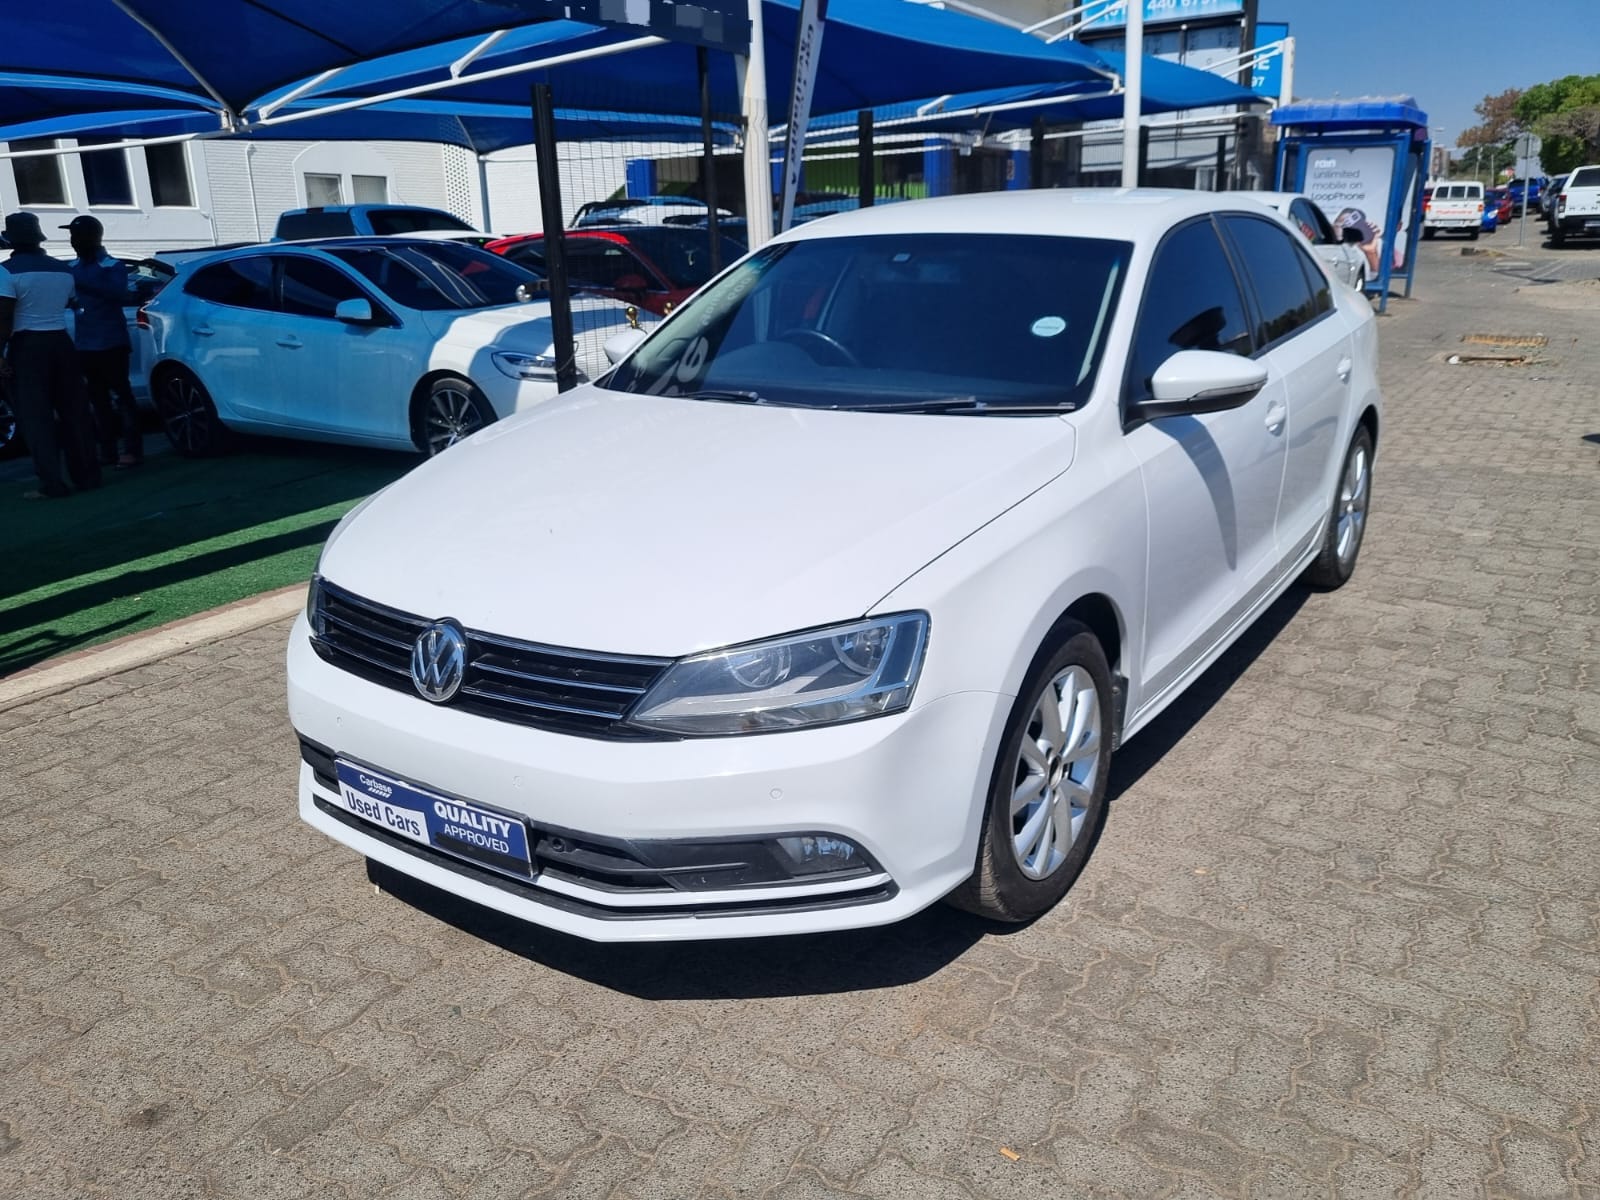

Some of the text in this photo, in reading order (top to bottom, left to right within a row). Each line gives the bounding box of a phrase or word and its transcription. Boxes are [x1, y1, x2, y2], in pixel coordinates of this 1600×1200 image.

[1313, 170, 1360, 178] unlimited
[1314, 158, 1336, 169] rain
[360, 774, 393, 794] Carbase
[345, 790, 421, 836] Used Cars
[433, 801, 511, 838] QUALITY
[444, 823, 510, 854] APPROVED
